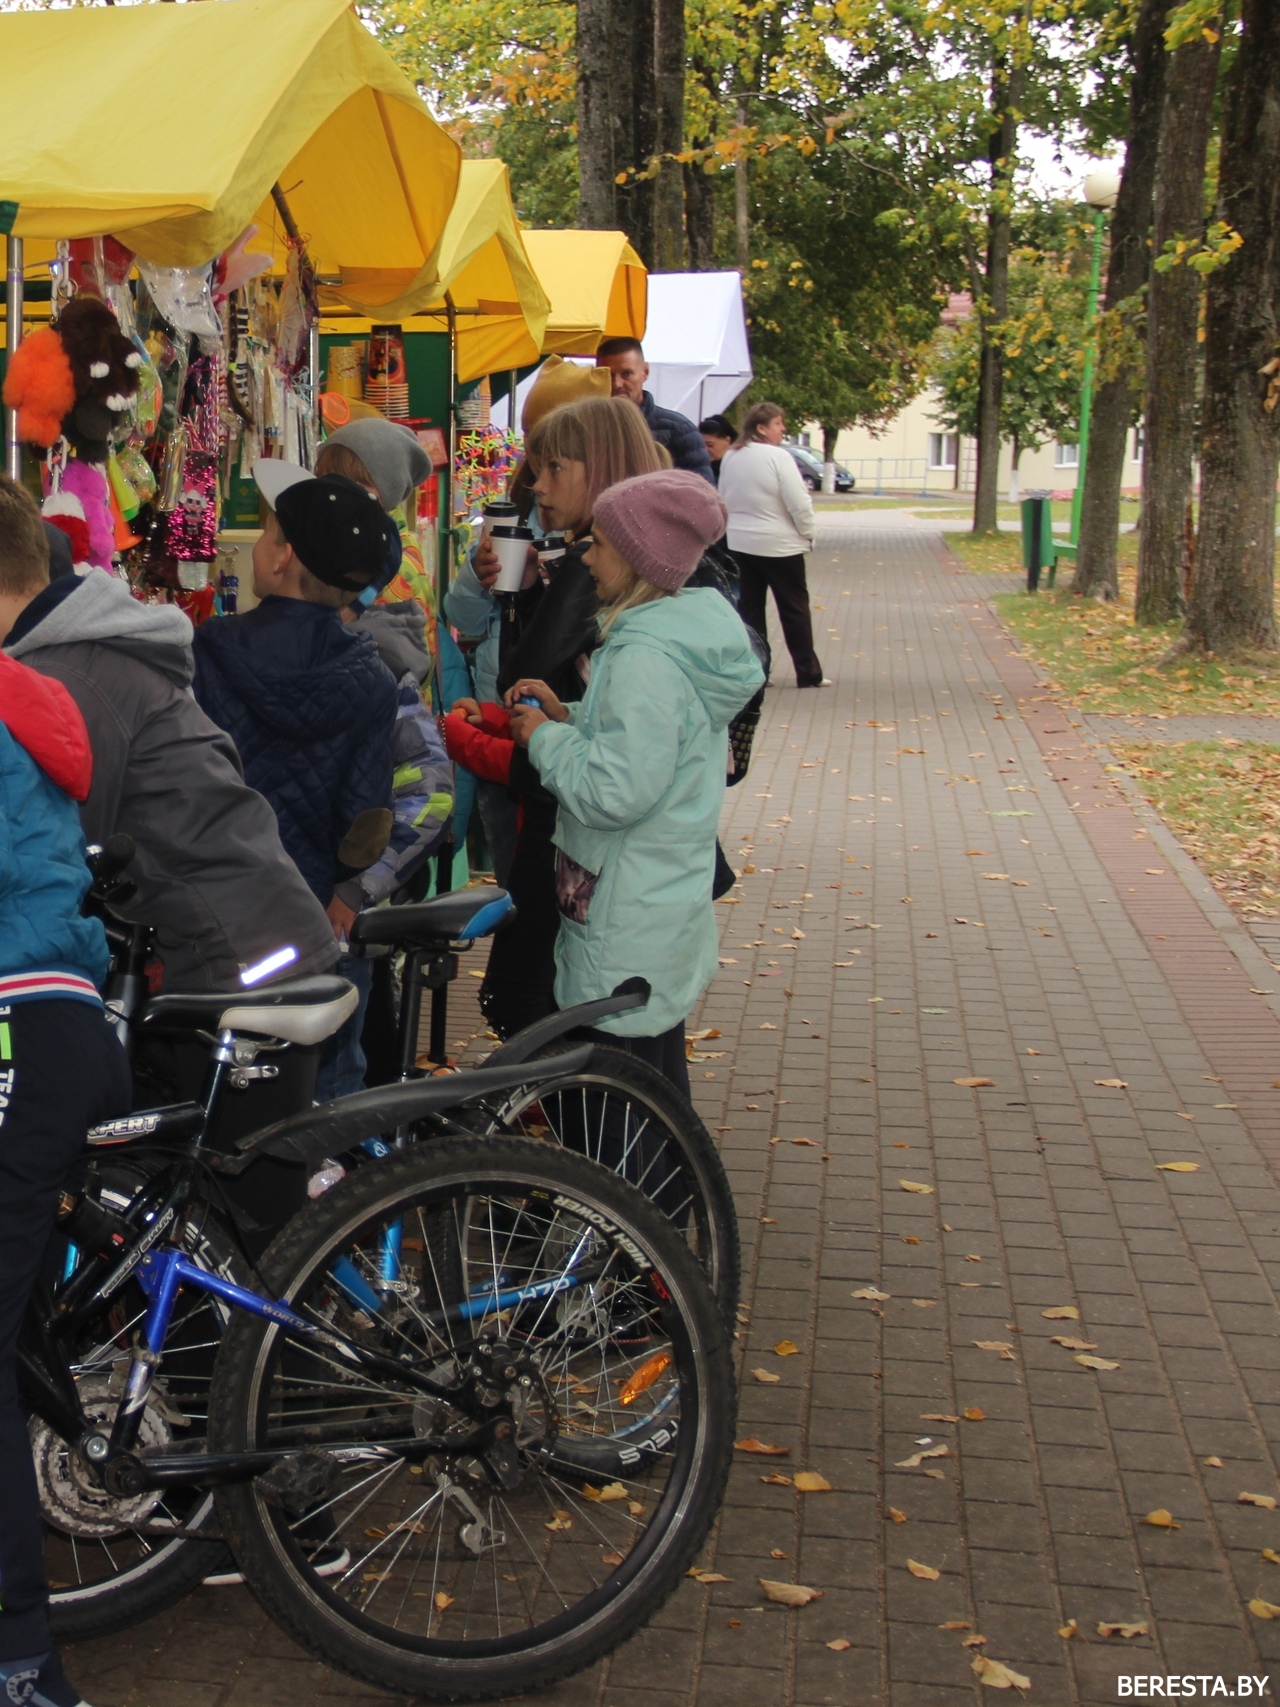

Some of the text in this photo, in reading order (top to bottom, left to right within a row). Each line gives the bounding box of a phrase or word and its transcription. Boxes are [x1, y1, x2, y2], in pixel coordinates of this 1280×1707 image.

[552, 1194, 652, 1269] HIGH POWER
[262, 1304, 306, 1329] WORLD
